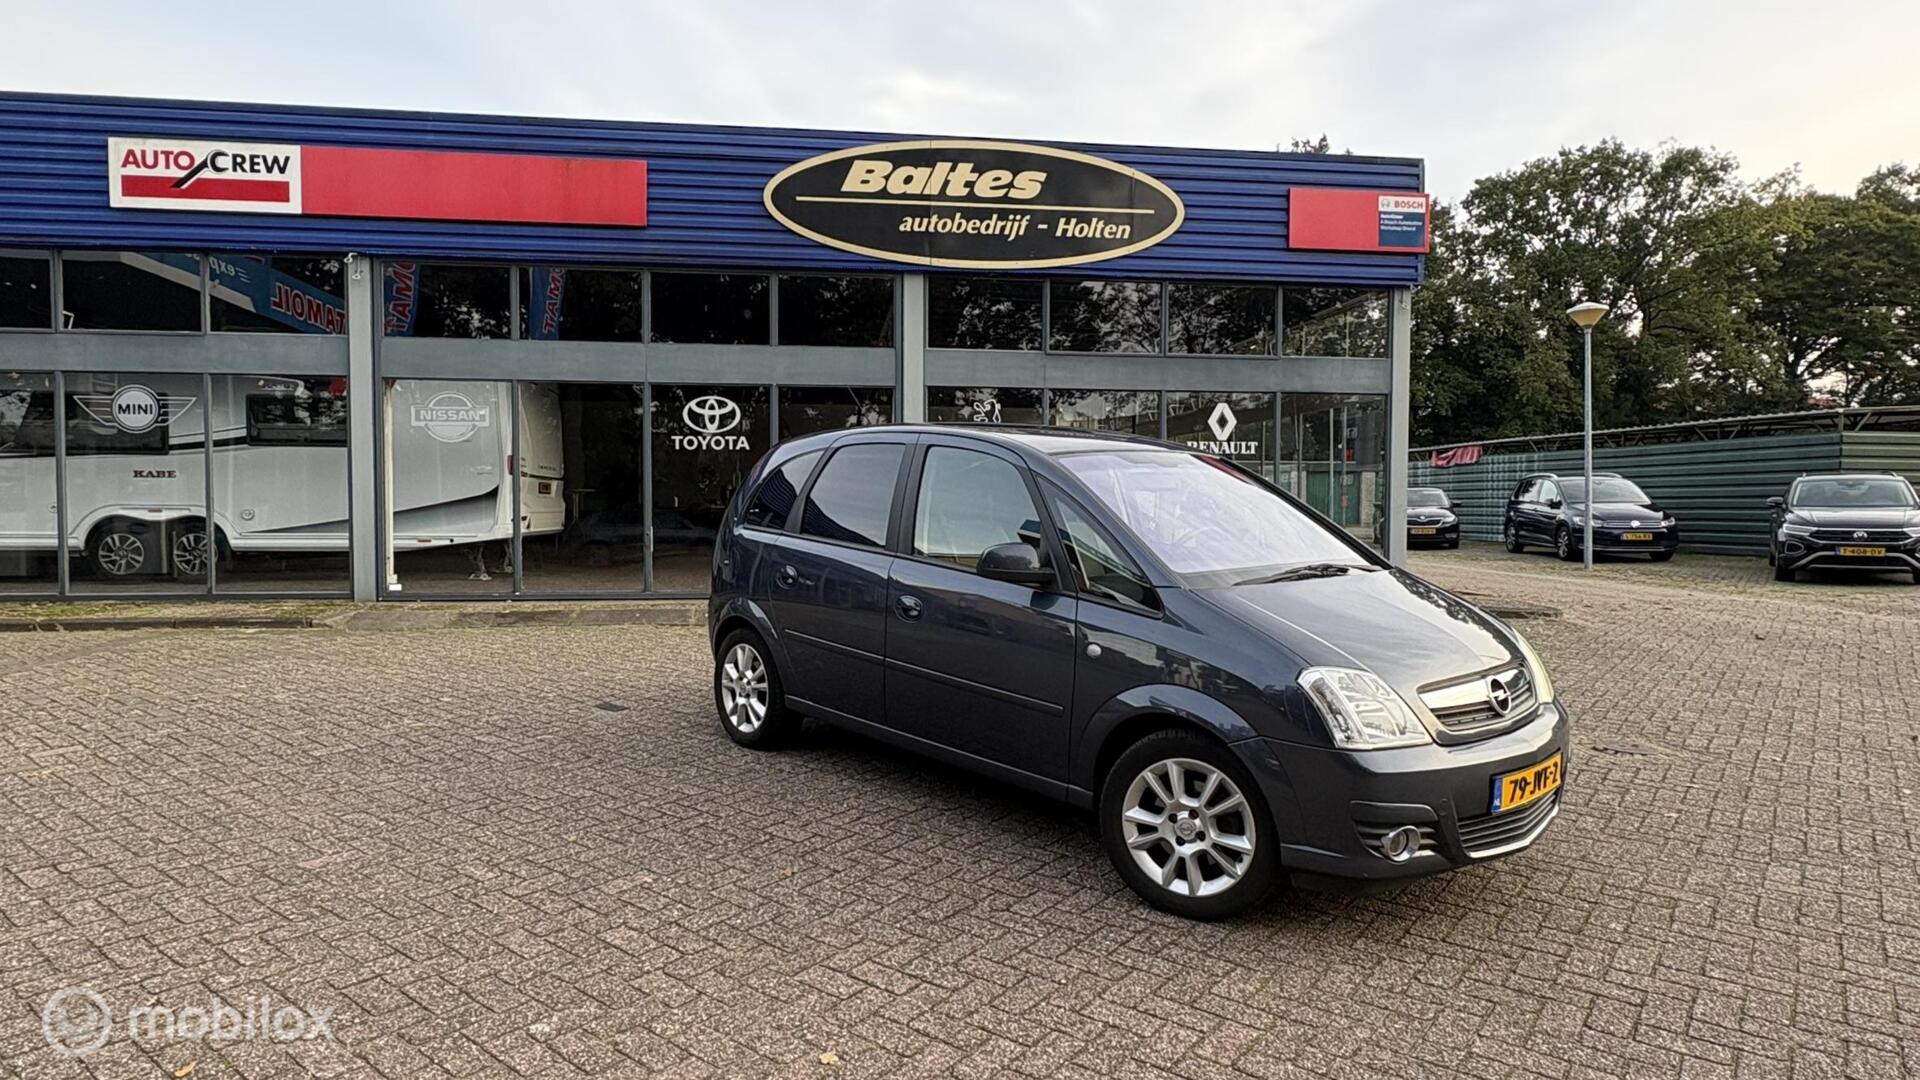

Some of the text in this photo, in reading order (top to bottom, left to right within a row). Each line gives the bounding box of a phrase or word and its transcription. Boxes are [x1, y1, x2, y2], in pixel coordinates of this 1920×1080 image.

[121, 148, 291, 174] AUTO CREW
[840, 159, 1047, 200] Baltes
[1394, 200, 1424, 209] BOSCH
[899, 212, 1031, 242] autobedrijf
[1055, 217, 1131, 240] Holten
[118, 403, 153, 415] MINI
[420, 410, 480, 421] NISSAN
[671, 435, 750, 450] TOYOTA
[133, 470, 176, 478] KABE
[1509, 760, 1559, 804] 79-JVF-2
